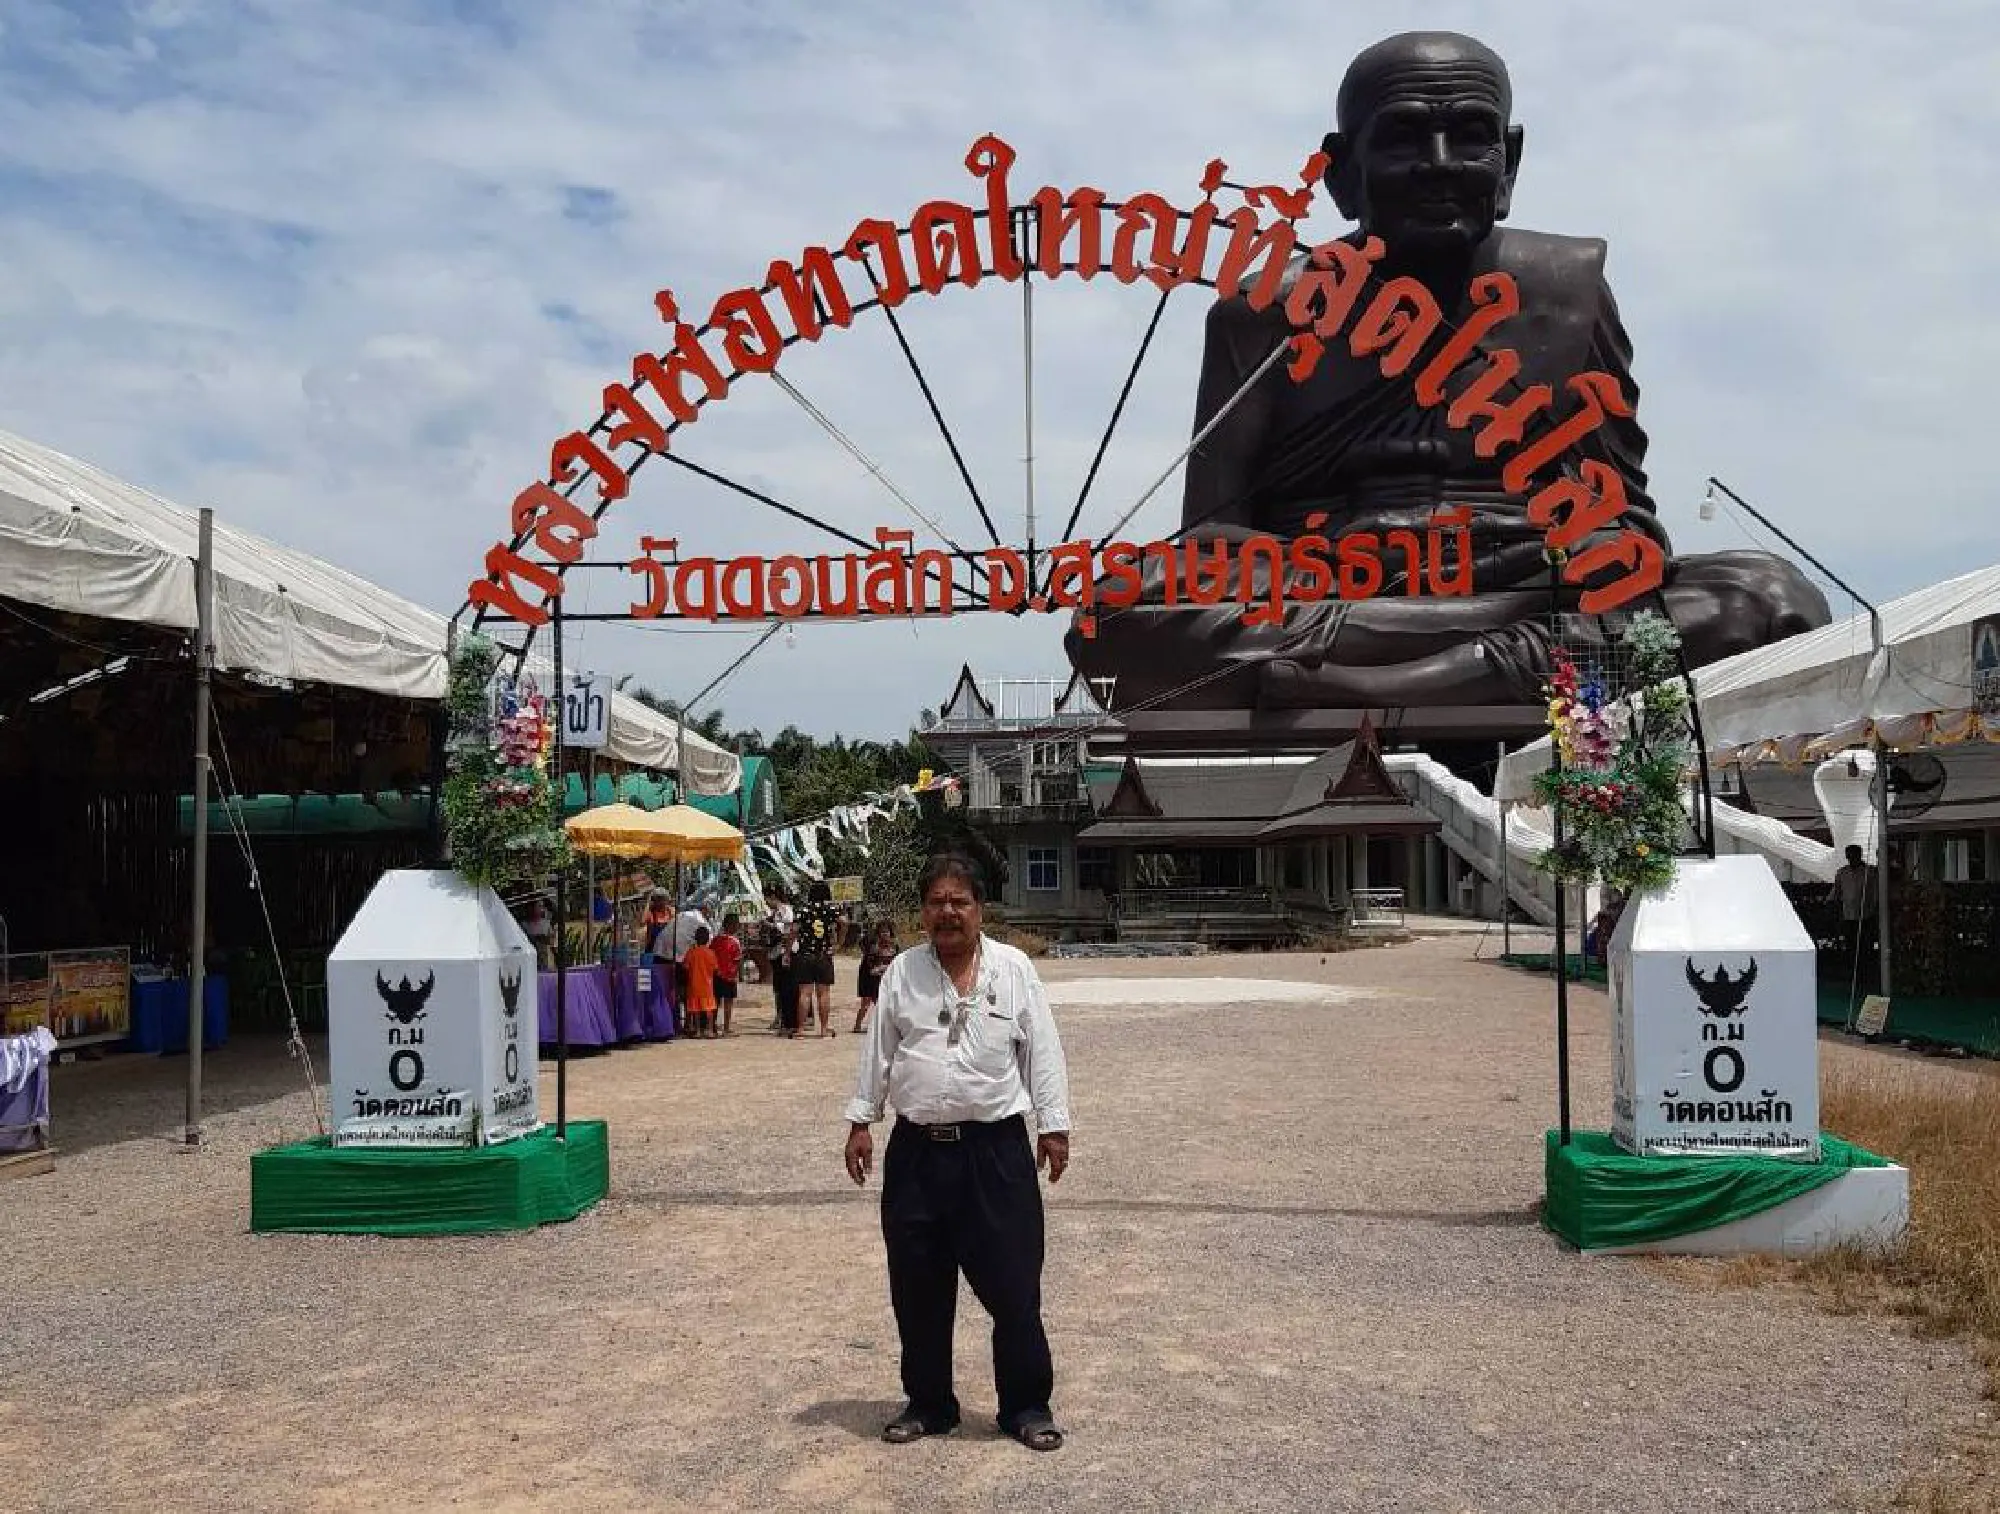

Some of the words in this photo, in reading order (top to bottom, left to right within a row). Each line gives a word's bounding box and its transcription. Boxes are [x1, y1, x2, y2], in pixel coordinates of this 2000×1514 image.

[631, 527, 952, 620] วัดดอนสัก
[389, 1028, 424, 1044] ก.ม
[1702, 1022, 1744, 1041] ก.ม
[1659, 1090, 1793, 1124] วัดดอนสัก
